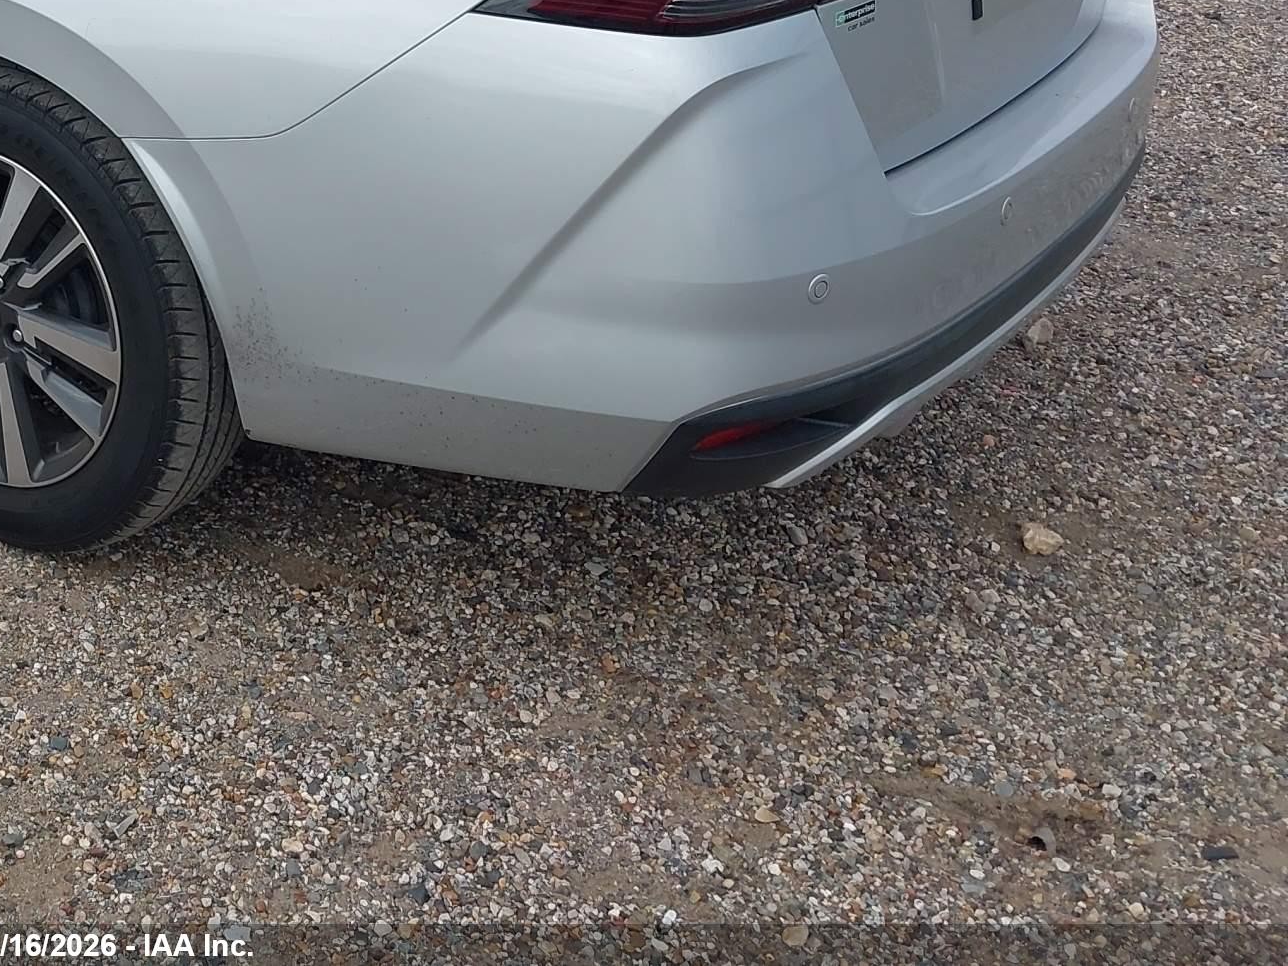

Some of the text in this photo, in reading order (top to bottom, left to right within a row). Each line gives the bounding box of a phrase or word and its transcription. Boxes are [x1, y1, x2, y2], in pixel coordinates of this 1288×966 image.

[838, 3, 875, 22] enterprise
[847, 16, 875, 32] car sales
